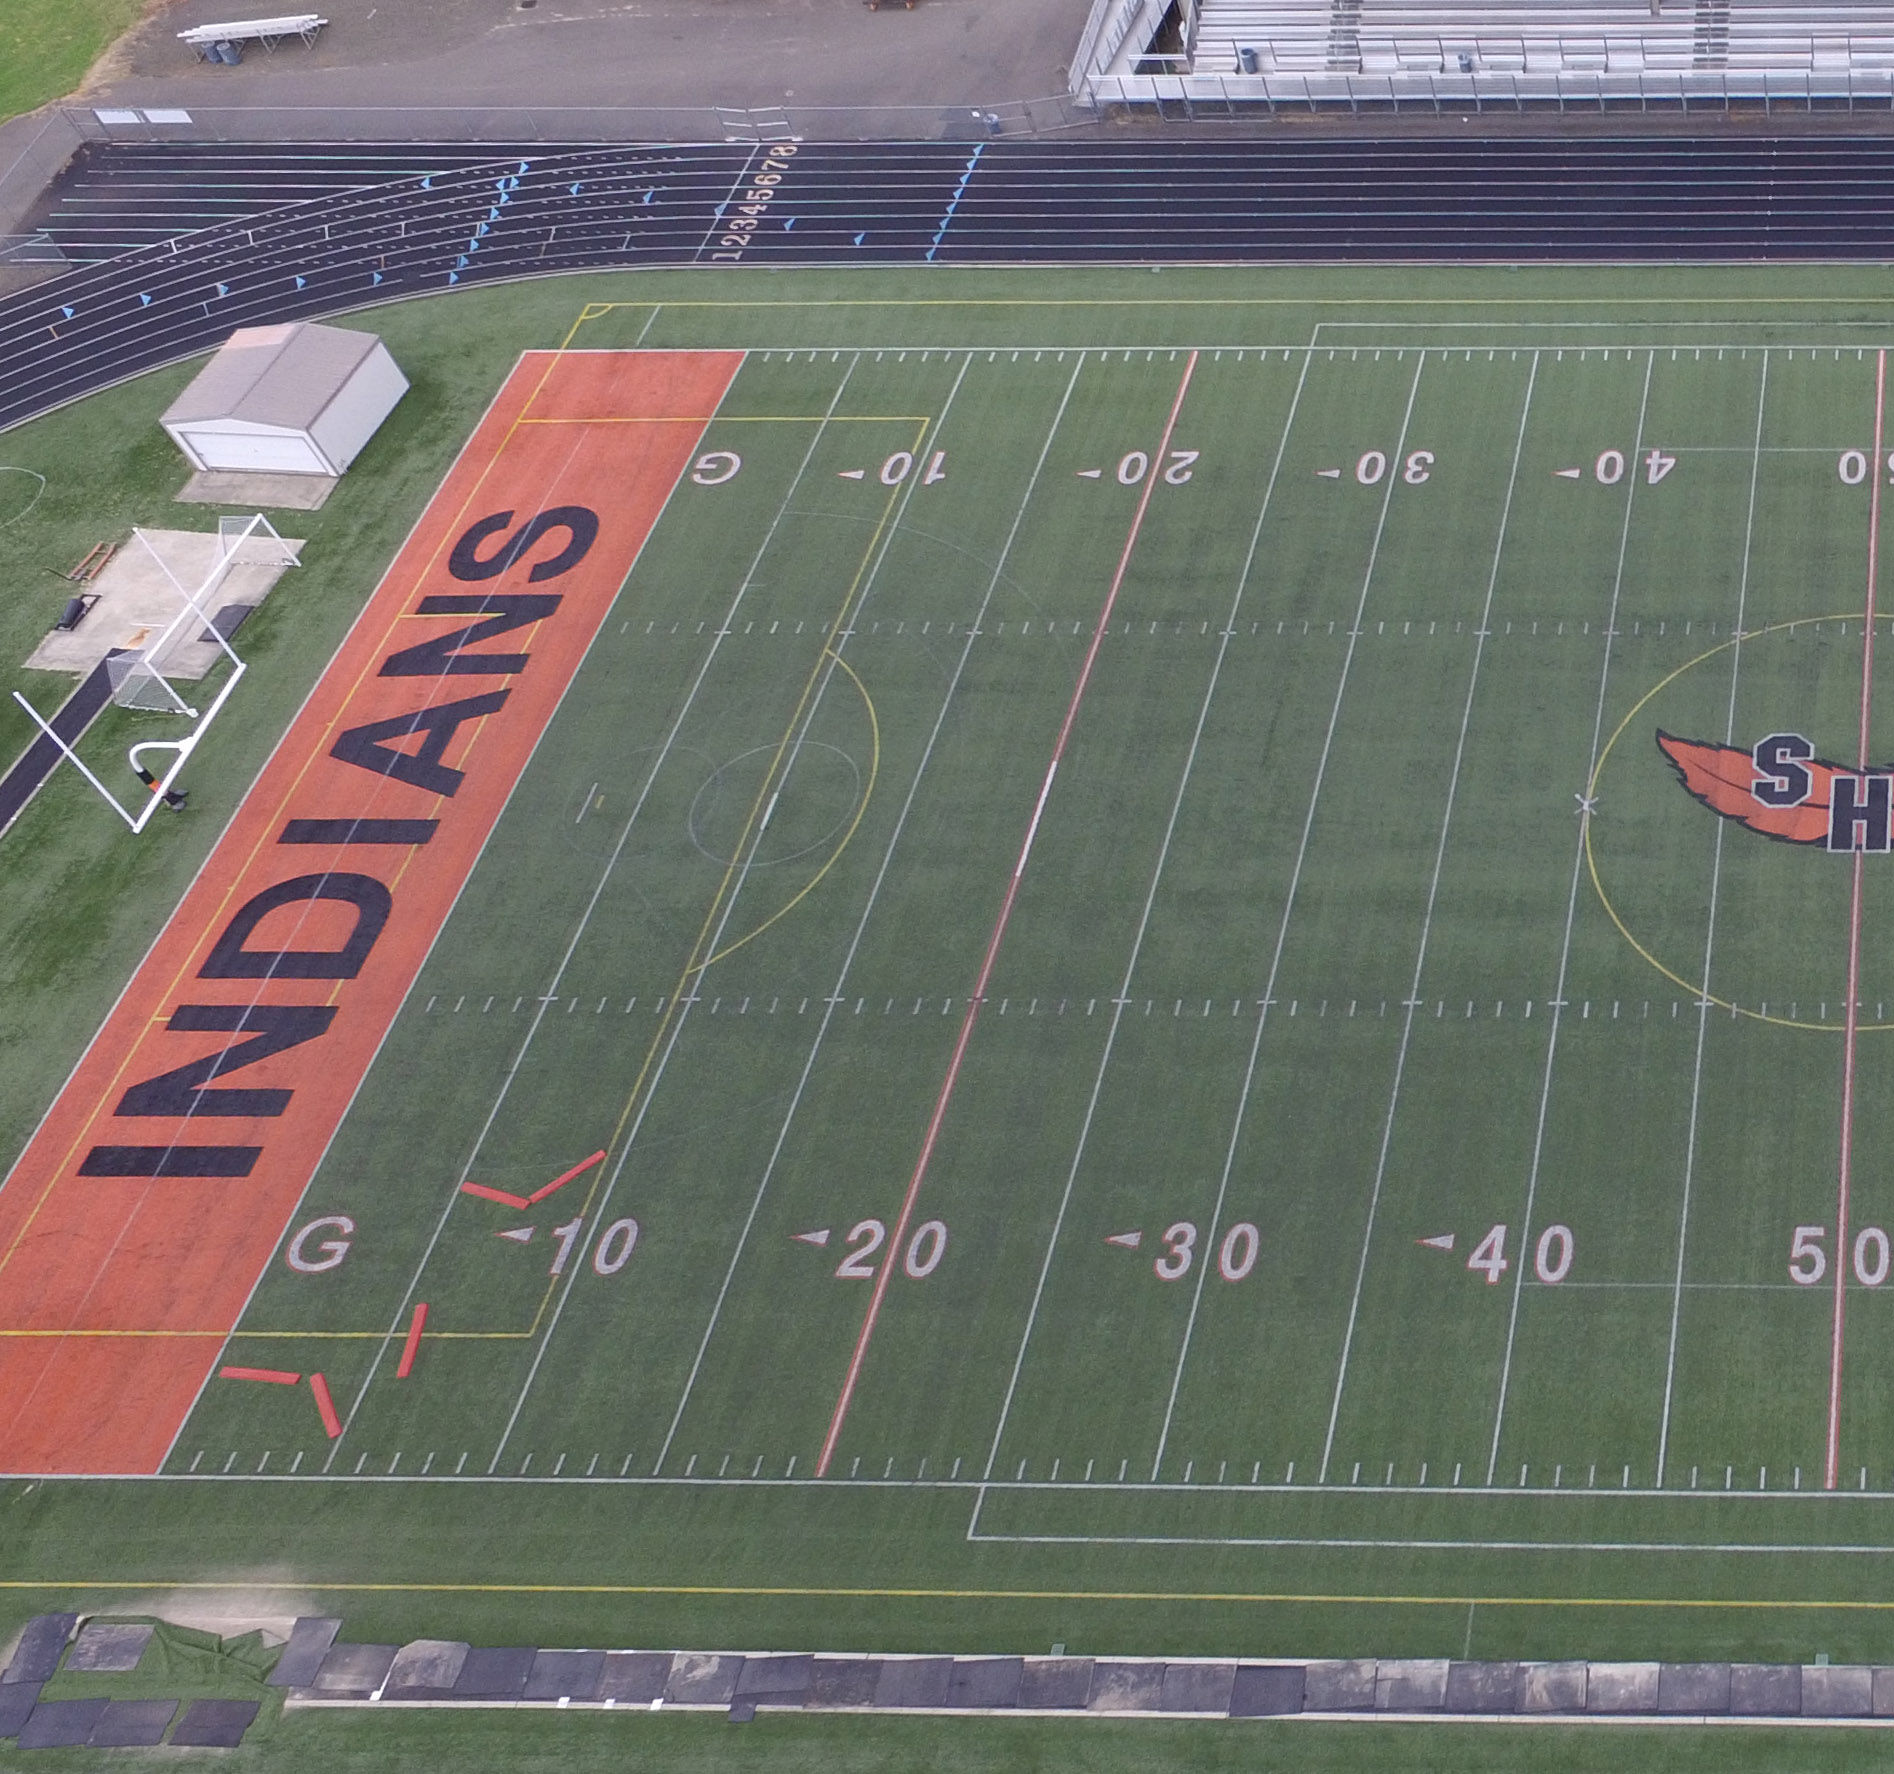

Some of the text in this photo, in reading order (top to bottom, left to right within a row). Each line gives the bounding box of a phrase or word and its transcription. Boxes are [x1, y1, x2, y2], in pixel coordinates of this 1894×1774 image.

[691, 451, 741, 486] G
[879, 451, 946, 486] 10
[1117, 450, 1200, 486] 20
[1355, 450, 1435, 486] 30
[1594, 450, 1676, 486] 40
[78, 505, 600, 1178] INDIANS
[284, 1215, 356, 1275] G
[549, 1217, 640, 1276] 10
[835, 1220, 949, 1280] 20
[1153, 1221, 1261, 1282] 30
[1467, 1223, 1574, 1284] 40
[1789, 1225, 1891, 1286] 50
